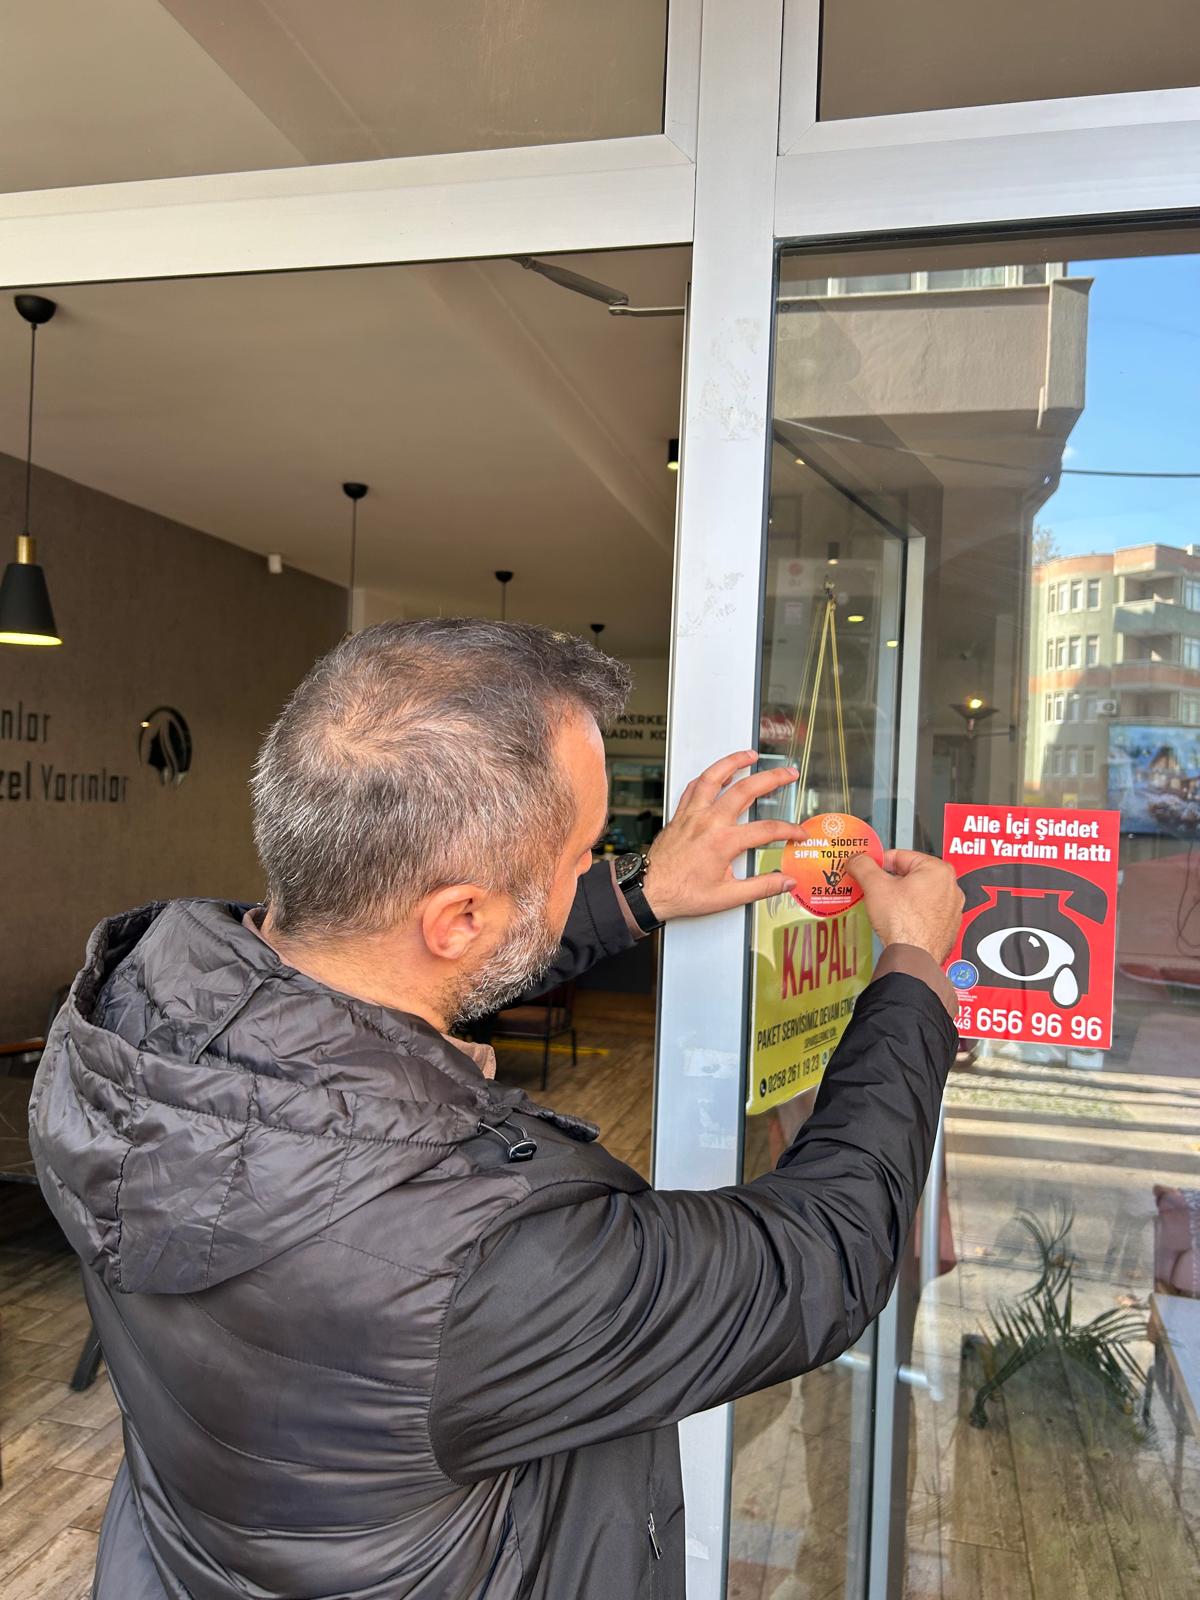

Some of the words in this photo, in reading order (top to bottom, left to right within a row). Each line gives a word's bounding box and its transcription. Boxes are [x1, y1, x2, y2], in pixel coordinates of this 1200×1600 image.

[963, 815, 1000, 834] Aile
[1006, 813, 1029, 839] İçi
[1035, 818, 1099, 840] Şiddet
[794, 850, 819, 859] SIFIR
[831, 837, 869, 848] ŞİDDETE
[949, 837, 985, 856] Acil
[991, 839, 1058, 859] Yardım
[1064, 843, 1111, 862] Hattı
[812, 886, 822, 895] 25
[825, 886, 853, 895] KASIM
[781, 913, 857, 999] KAPALI
[757, 1024, 781, 1051] PAKET
[820, 1001, 839, 1026] DEVAM
[976, 1007, 1022, 1034] 656
[1031, 1012, 1062, 1038] 96
[1070, 1015, 1102, 1041] 96
[768, 1069, 786, 1093] 0258
[788, 1063, 800, 1084] 261
[803, 1058, 810, 1076] 19
[811, 1054, 819, 1072] 23
